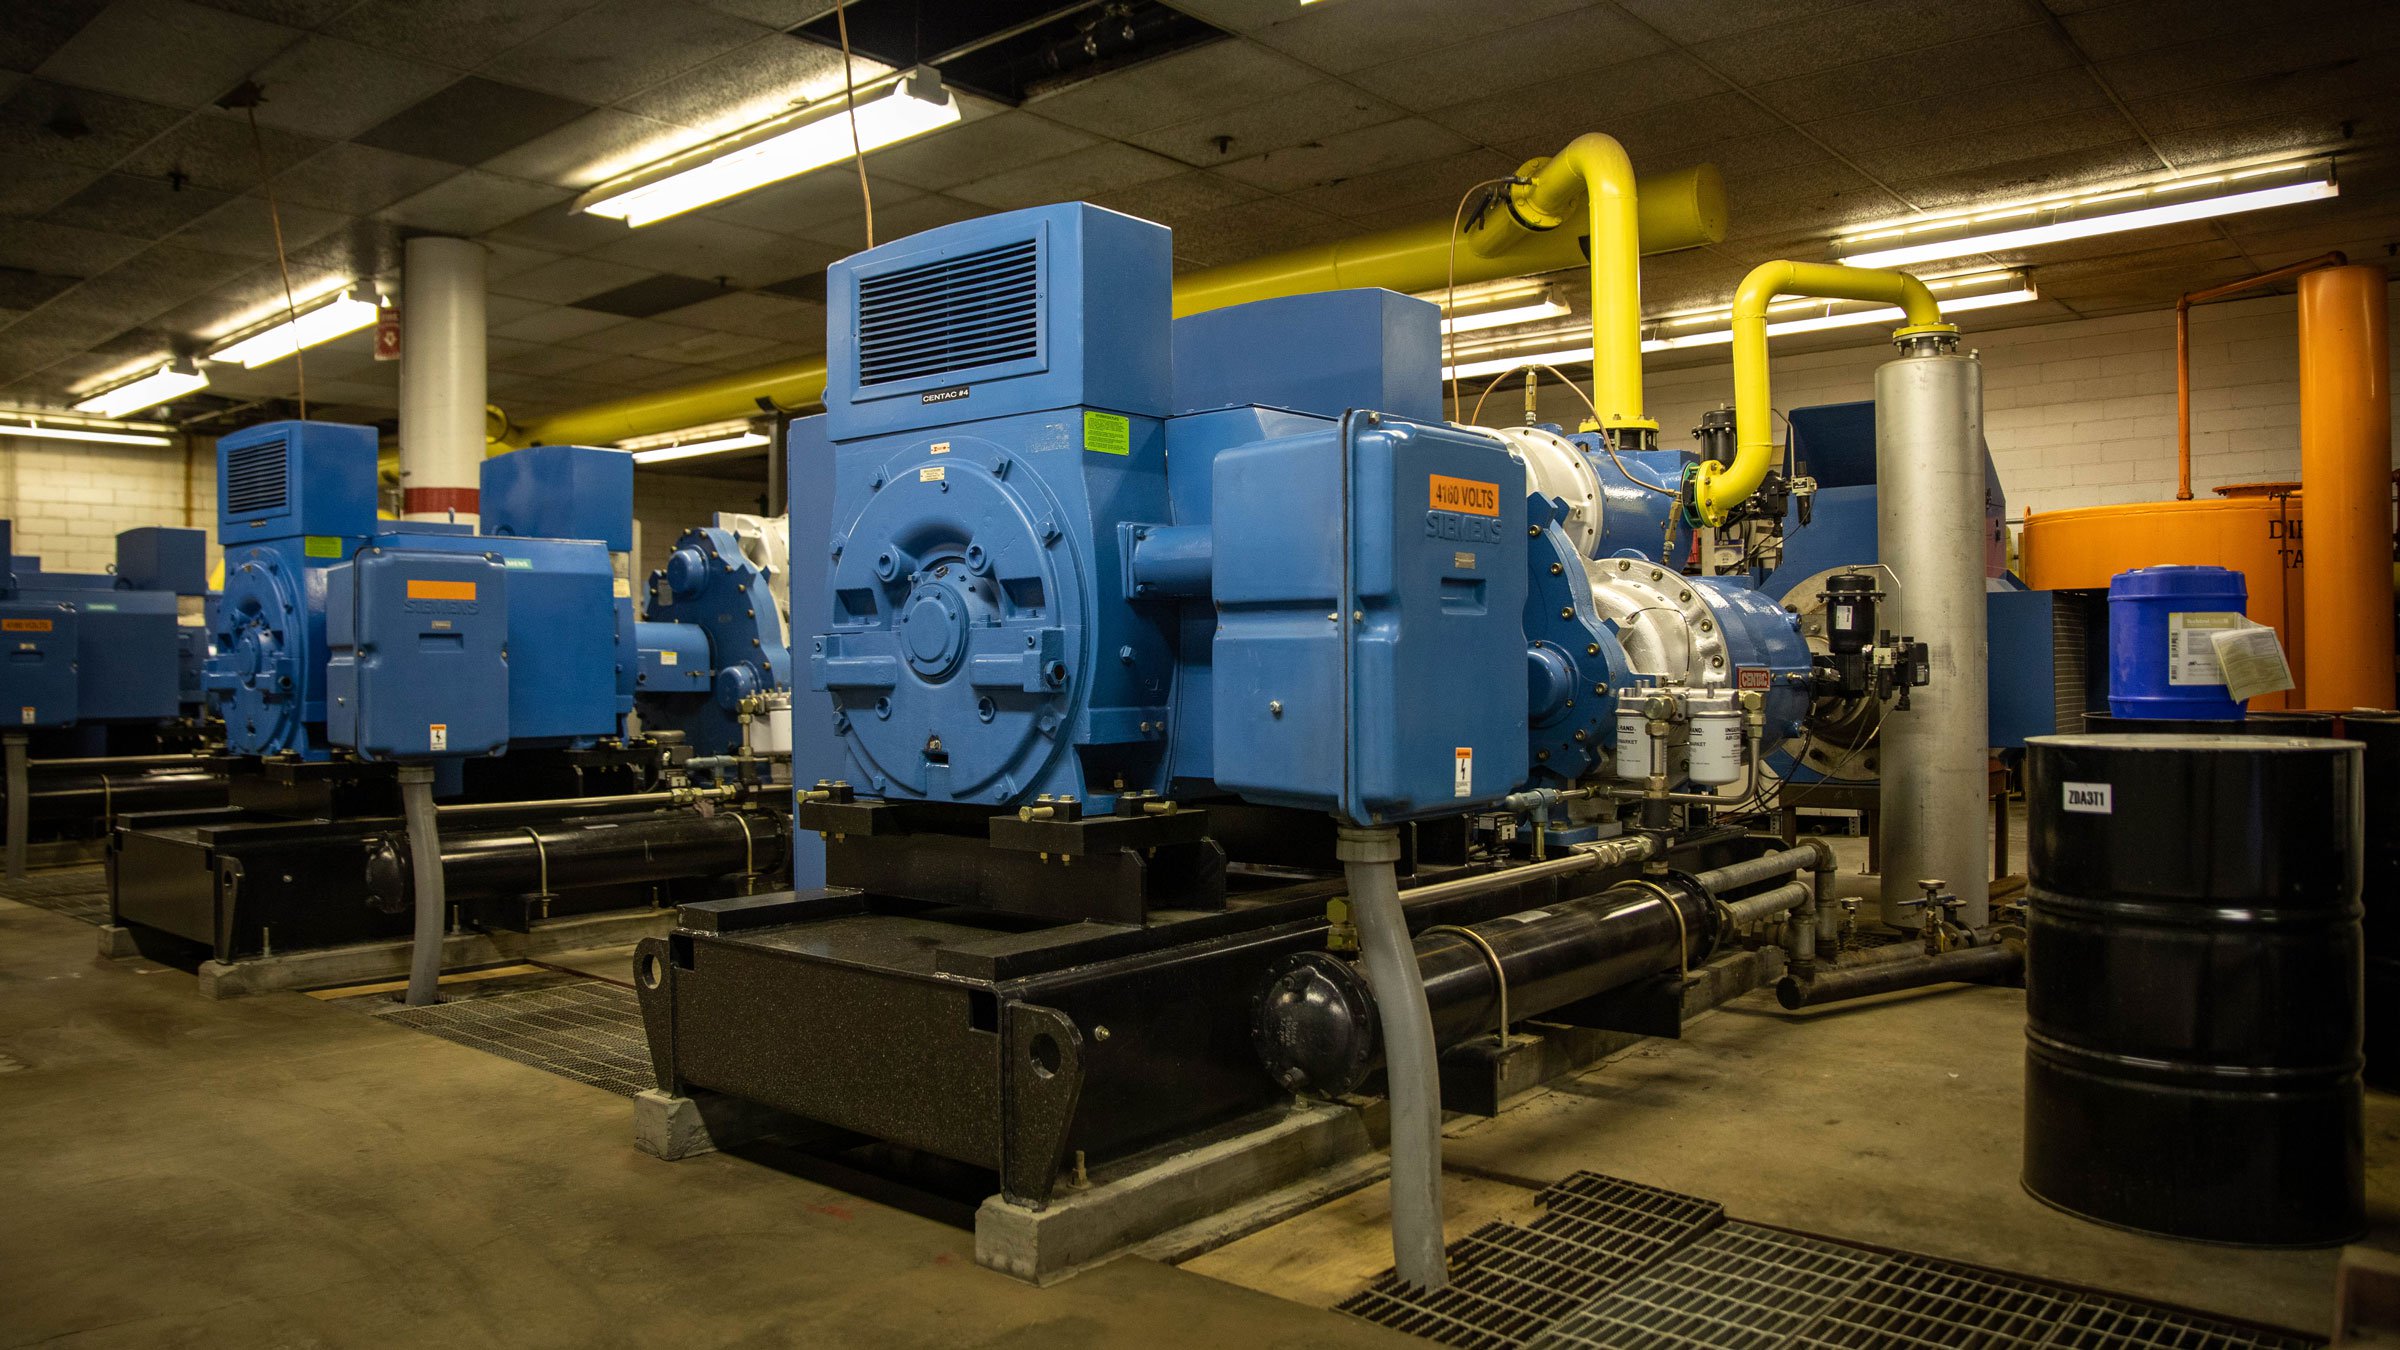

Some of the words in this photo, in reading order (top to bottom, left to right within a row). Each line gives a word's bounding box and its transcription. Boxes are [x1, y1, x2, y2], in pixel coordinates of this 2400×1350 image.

[922, 391, 957, 402] CENTAC
[958, 389, 969, 397] #4
[1436, 484, 1459, 505] 4160
[1461, 486, 1494, 510] VOLTS
[1425, 509, 1502, 545] SIEMENS
[1741, 671, 1768, 687] CENTAC
